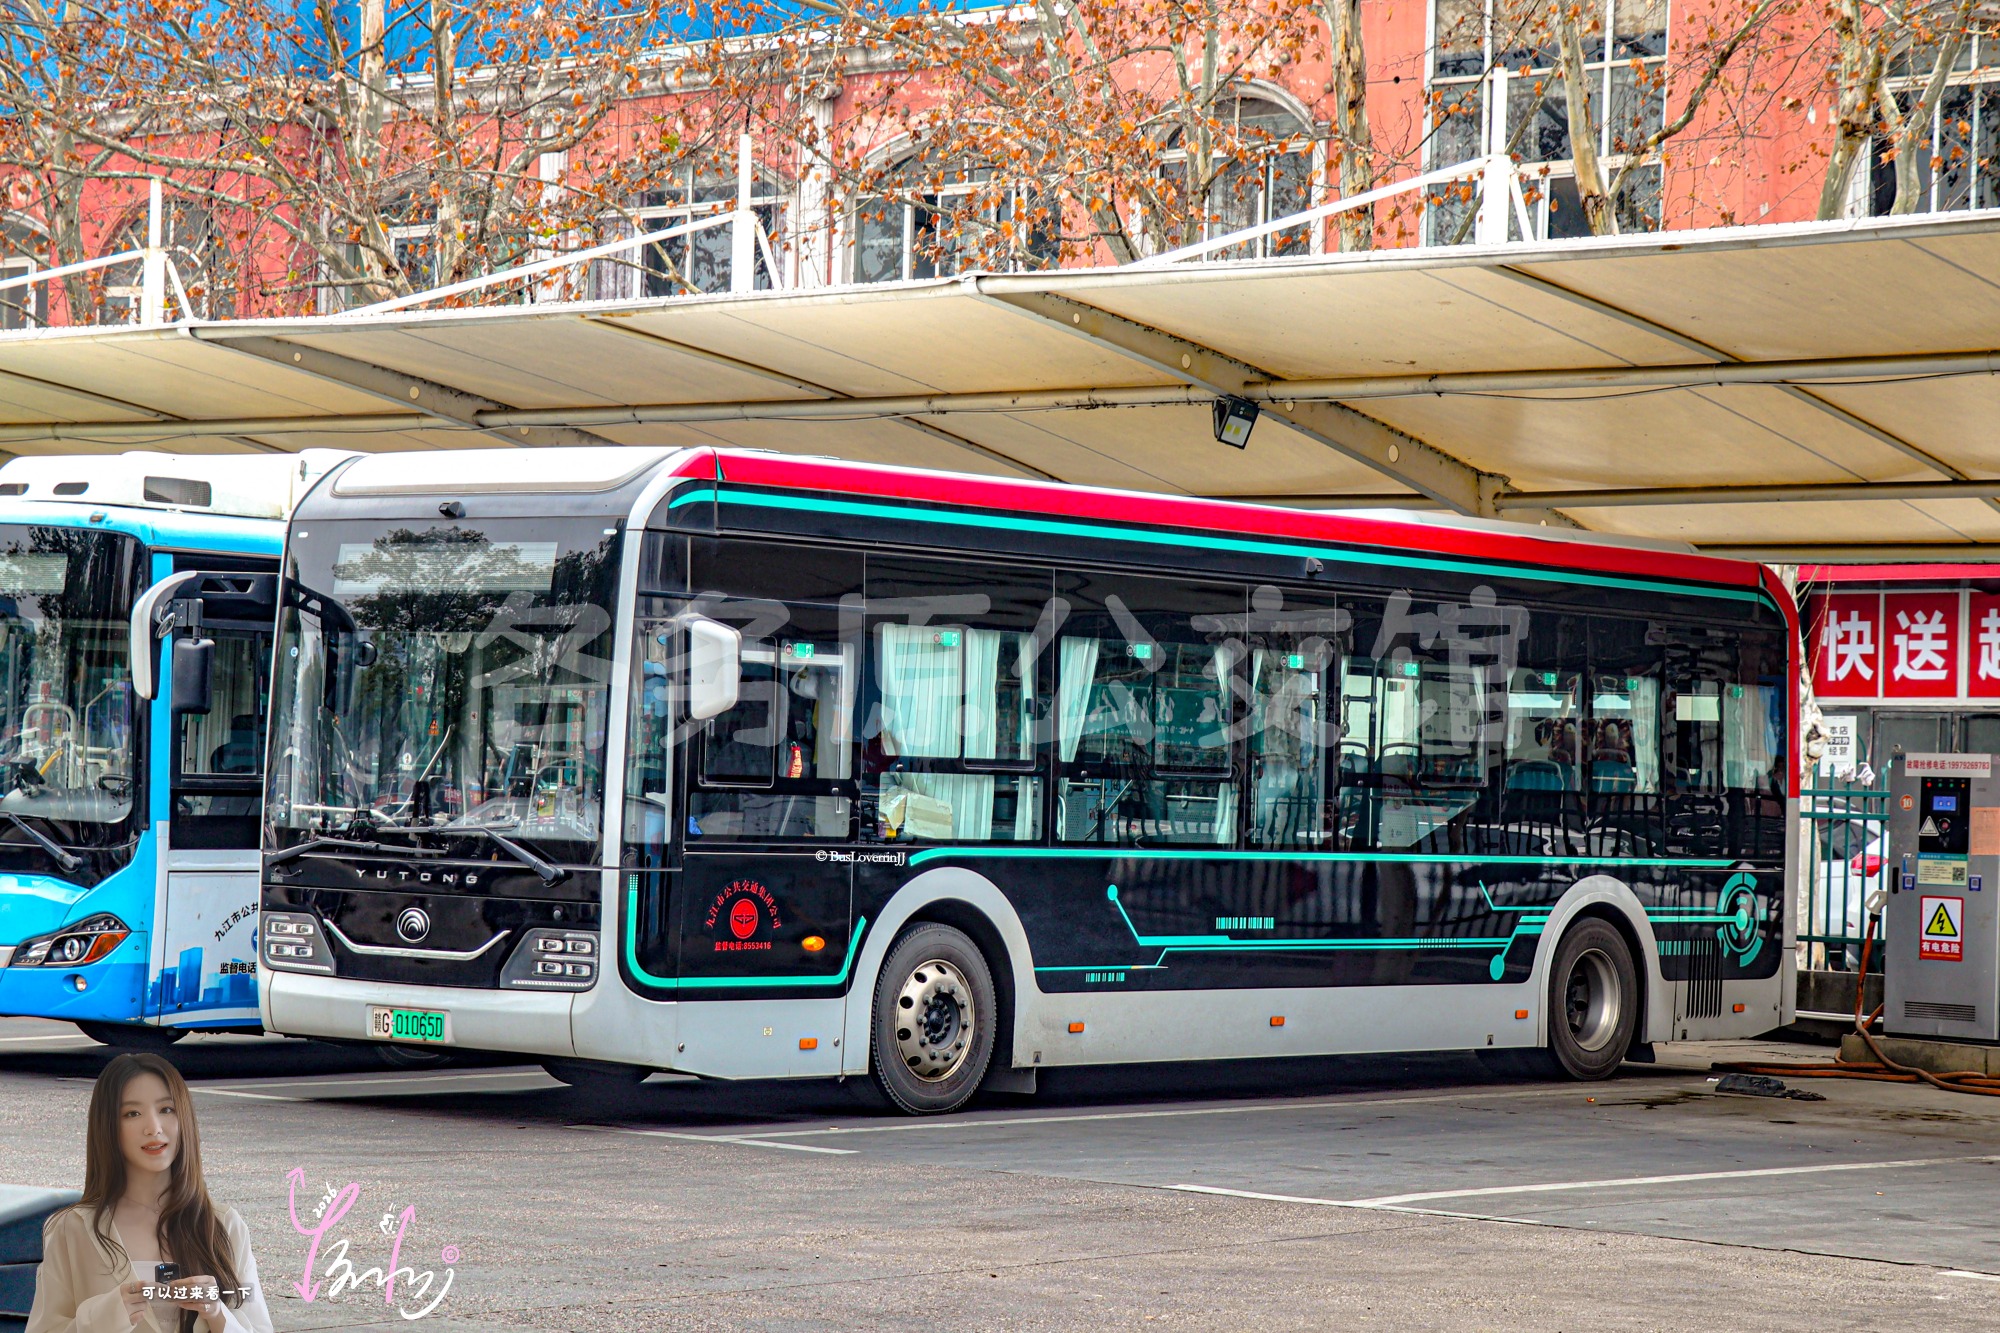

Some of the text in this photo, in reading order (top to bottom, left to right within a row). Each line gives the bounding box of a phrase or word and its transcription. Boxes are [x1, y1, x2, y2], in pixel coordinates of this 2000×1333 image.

[1829, 726, 1848, 735] 本店
[1829, 747, 1848, 756] 经营
[1903, 798, 1913, 808] 10
[356, 869, 479, 884] YUTONG
[705, 879, 783, 930] 九江市公共交通集团公司
[714, 940, 772, 952] 监督电话:8553416
[1921, 941, 1961, 954] 有电危险
[219, 962, 257, 974] 监督电话
